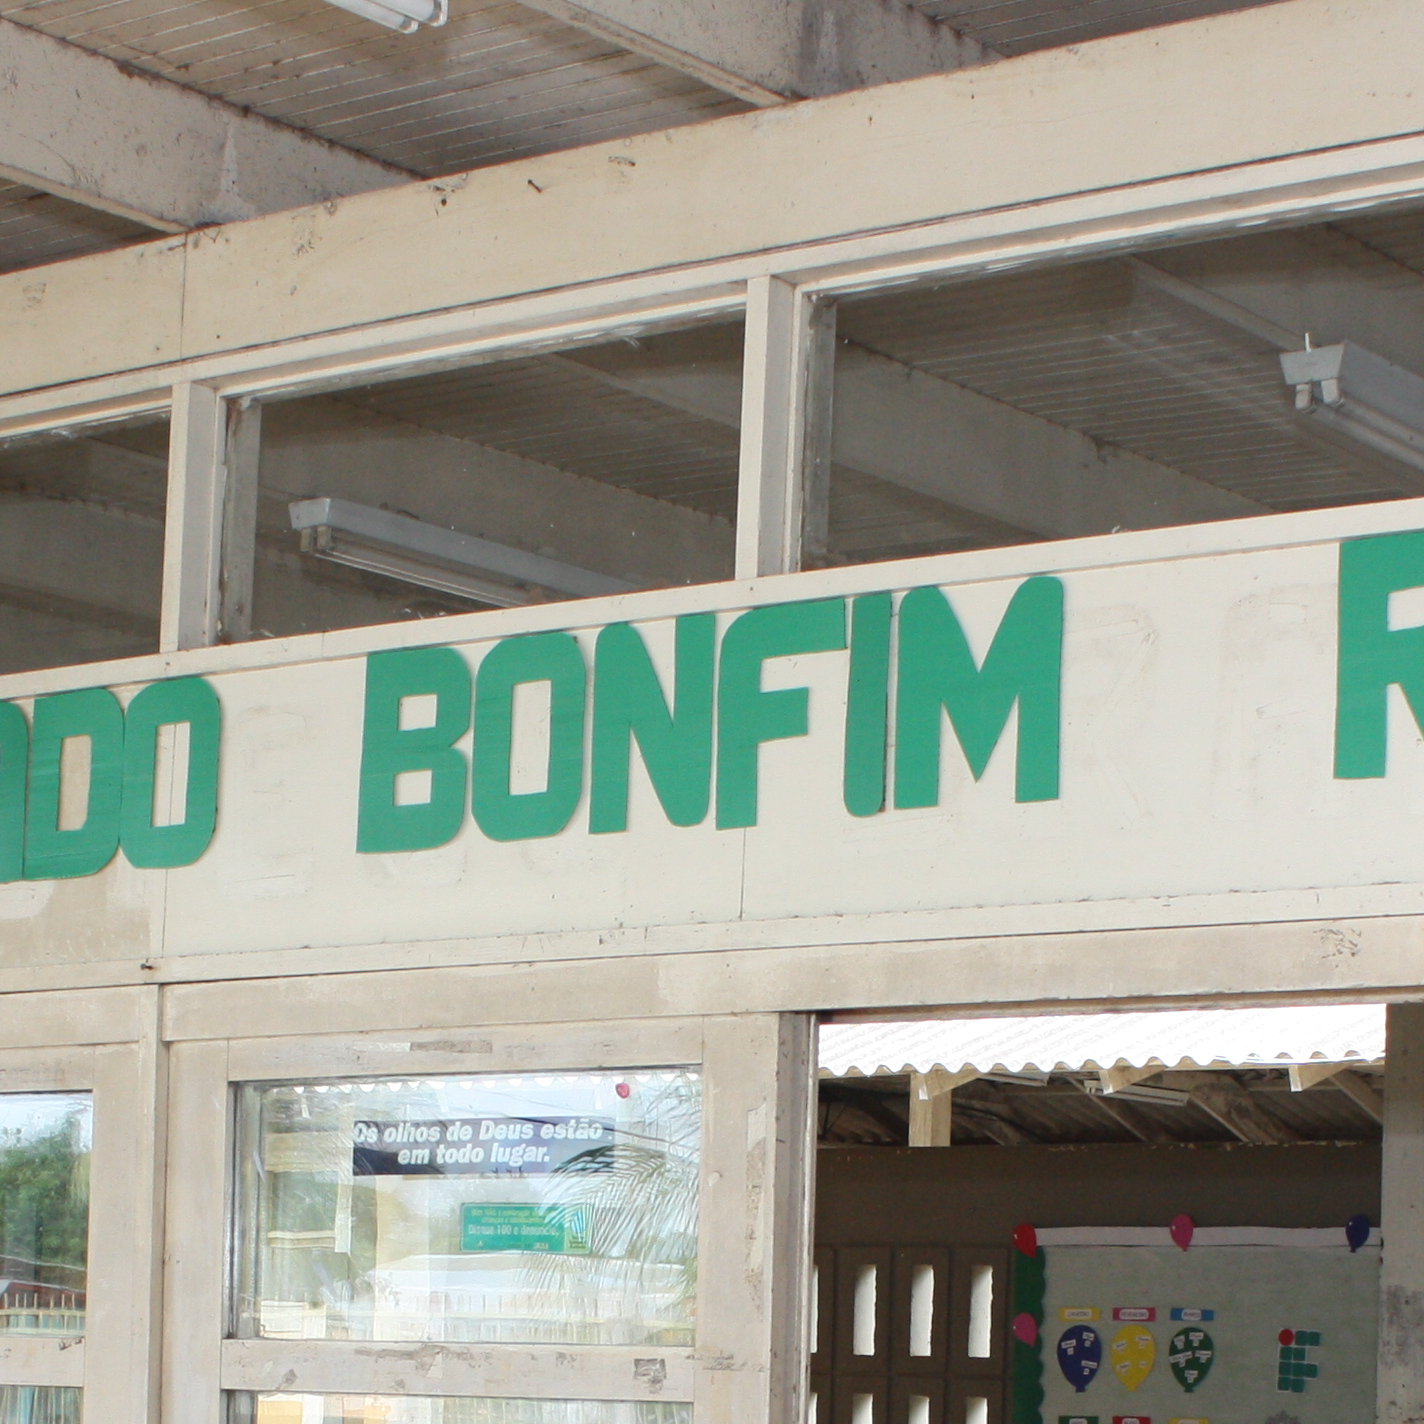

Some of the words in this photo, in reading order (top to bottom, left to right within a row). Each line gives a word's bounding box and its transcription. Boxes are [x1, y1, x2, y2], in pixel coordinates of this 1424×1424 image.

[356, 576, 1063, 853] BONFIM
[353, 1122, 378, 1143] Os
[384, 1121, 440, 1143] olhos
[446, 1121, 472, 1141] de
[479, 1120, 533, 1141] Deus
[540, 1118, 604, 1140] estão
[397, 1148, 430, 1165] em
[436, 1143, 484, 1165] todo
[490, 1144, 550, 1167] lugar.
